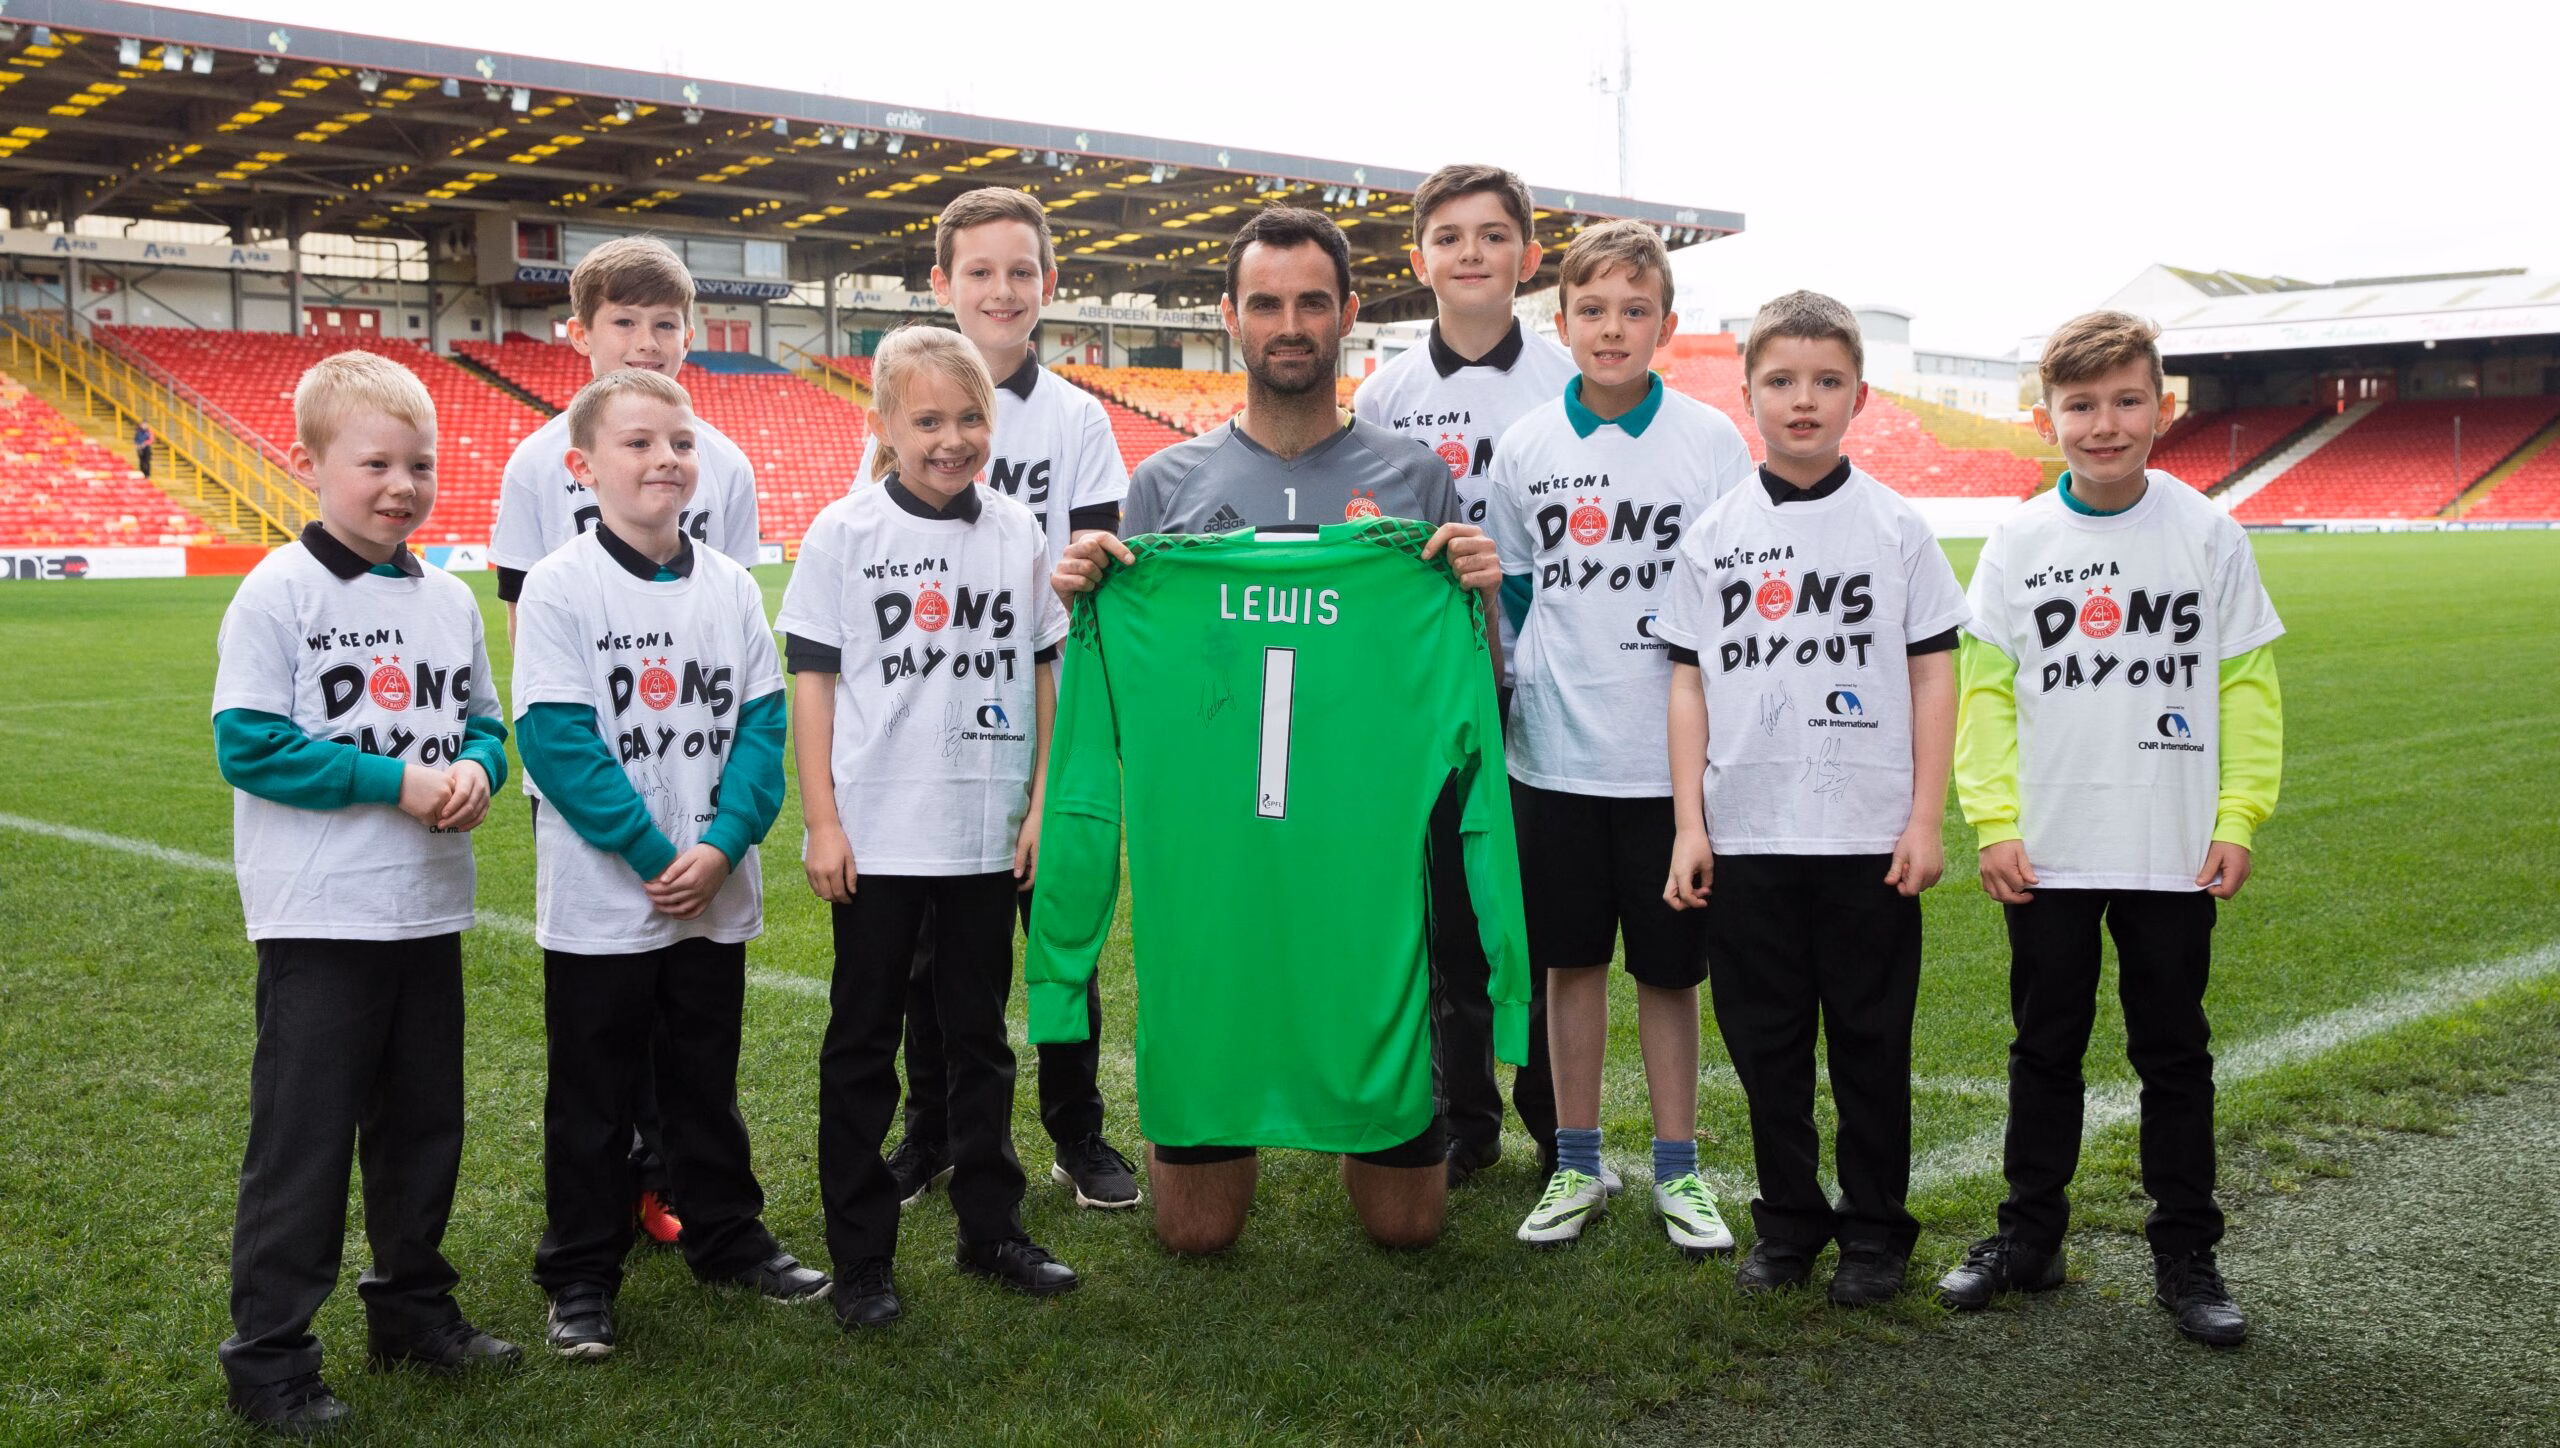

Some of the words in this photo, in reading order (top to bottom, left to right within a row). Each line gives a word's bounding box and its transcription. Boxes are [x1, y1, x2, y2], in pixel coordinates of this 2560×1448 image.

[886, 109, 926, 129] entier
[757, 284, 789, 297] LTD
[1078, 306, 1149, 321] ABERDEEN
[1393, 410, 1433, 430] WE'RE
[1438, 411, 1460, 425] ON
[1464, 411, 1471, 424] A
[1528, 473, 1569, 496] WE'RE
[1573, 475, 1597, 488] ON
[1601, 474, 1610, 487] A
[1283, 487, 1296, 521] 1
[1203, 517, 1246, 533] adidas
[1759, 547, 1781, 563] ON
[1785, 545, 1795, 559] A
[863, 559, 908, 580] WE'RE
[914, 557, 935, 576] ON
[940, 557, 949, 572] A
[2025, 565, 2074, 589] WE'RE
[2080, 562, 2104, 581] ON
[2110, 561, 2120, 576] A
[1220, 583, 1340, 626] LEWIS
[307, 628, 360, 650] WE'RE
[365, 629, 389, 647] ON
[395, 629, 404, 645] A
[597, 631, 632, 651] W'RE
[637, 632, 659, 649] ON
[664, 631, 674, 647] A
[1620, 642, 1638, 650] CNR
[1640, 642, 1670, 651] Interna
[1256, 646, 1297, 820] 1
[1808, 719, 1827, 728] CNR
[1829, 719, 1879, 729] International
[961, 732, 978, 741] CNR
[979, 732, 1026, 742] International
[2138, 742, 2159, 751] CNR
[2160, 742, 2204, 752] International
[1267, 800, 1283, 808] SPFL
